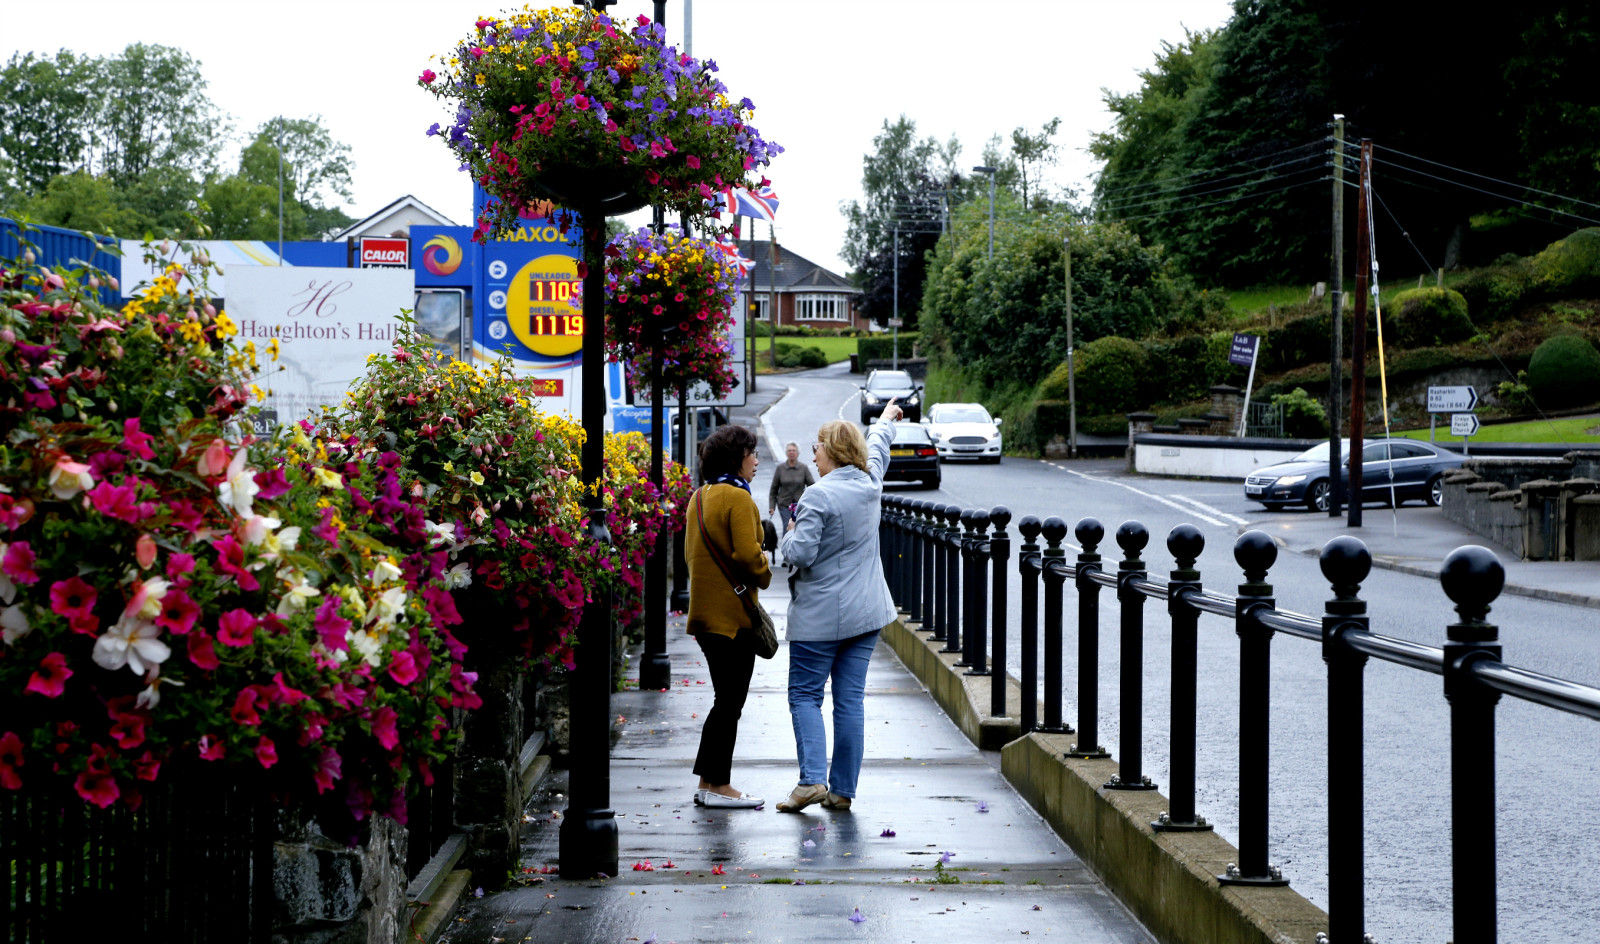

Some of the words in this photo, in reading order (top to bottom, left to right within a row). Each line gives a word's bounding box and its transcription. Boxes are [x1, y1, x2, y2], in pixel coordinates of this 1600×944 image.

[496, 226, 569, 242] MAXOL
[364, 250, 406, 264] CALOR
[529, 272, 571, 280] UNLEADED
[529, 306, 555, 314] DIESEL
[240, 319, 350, 344] Haughton's
[358, 322, 402, 341] Hall
